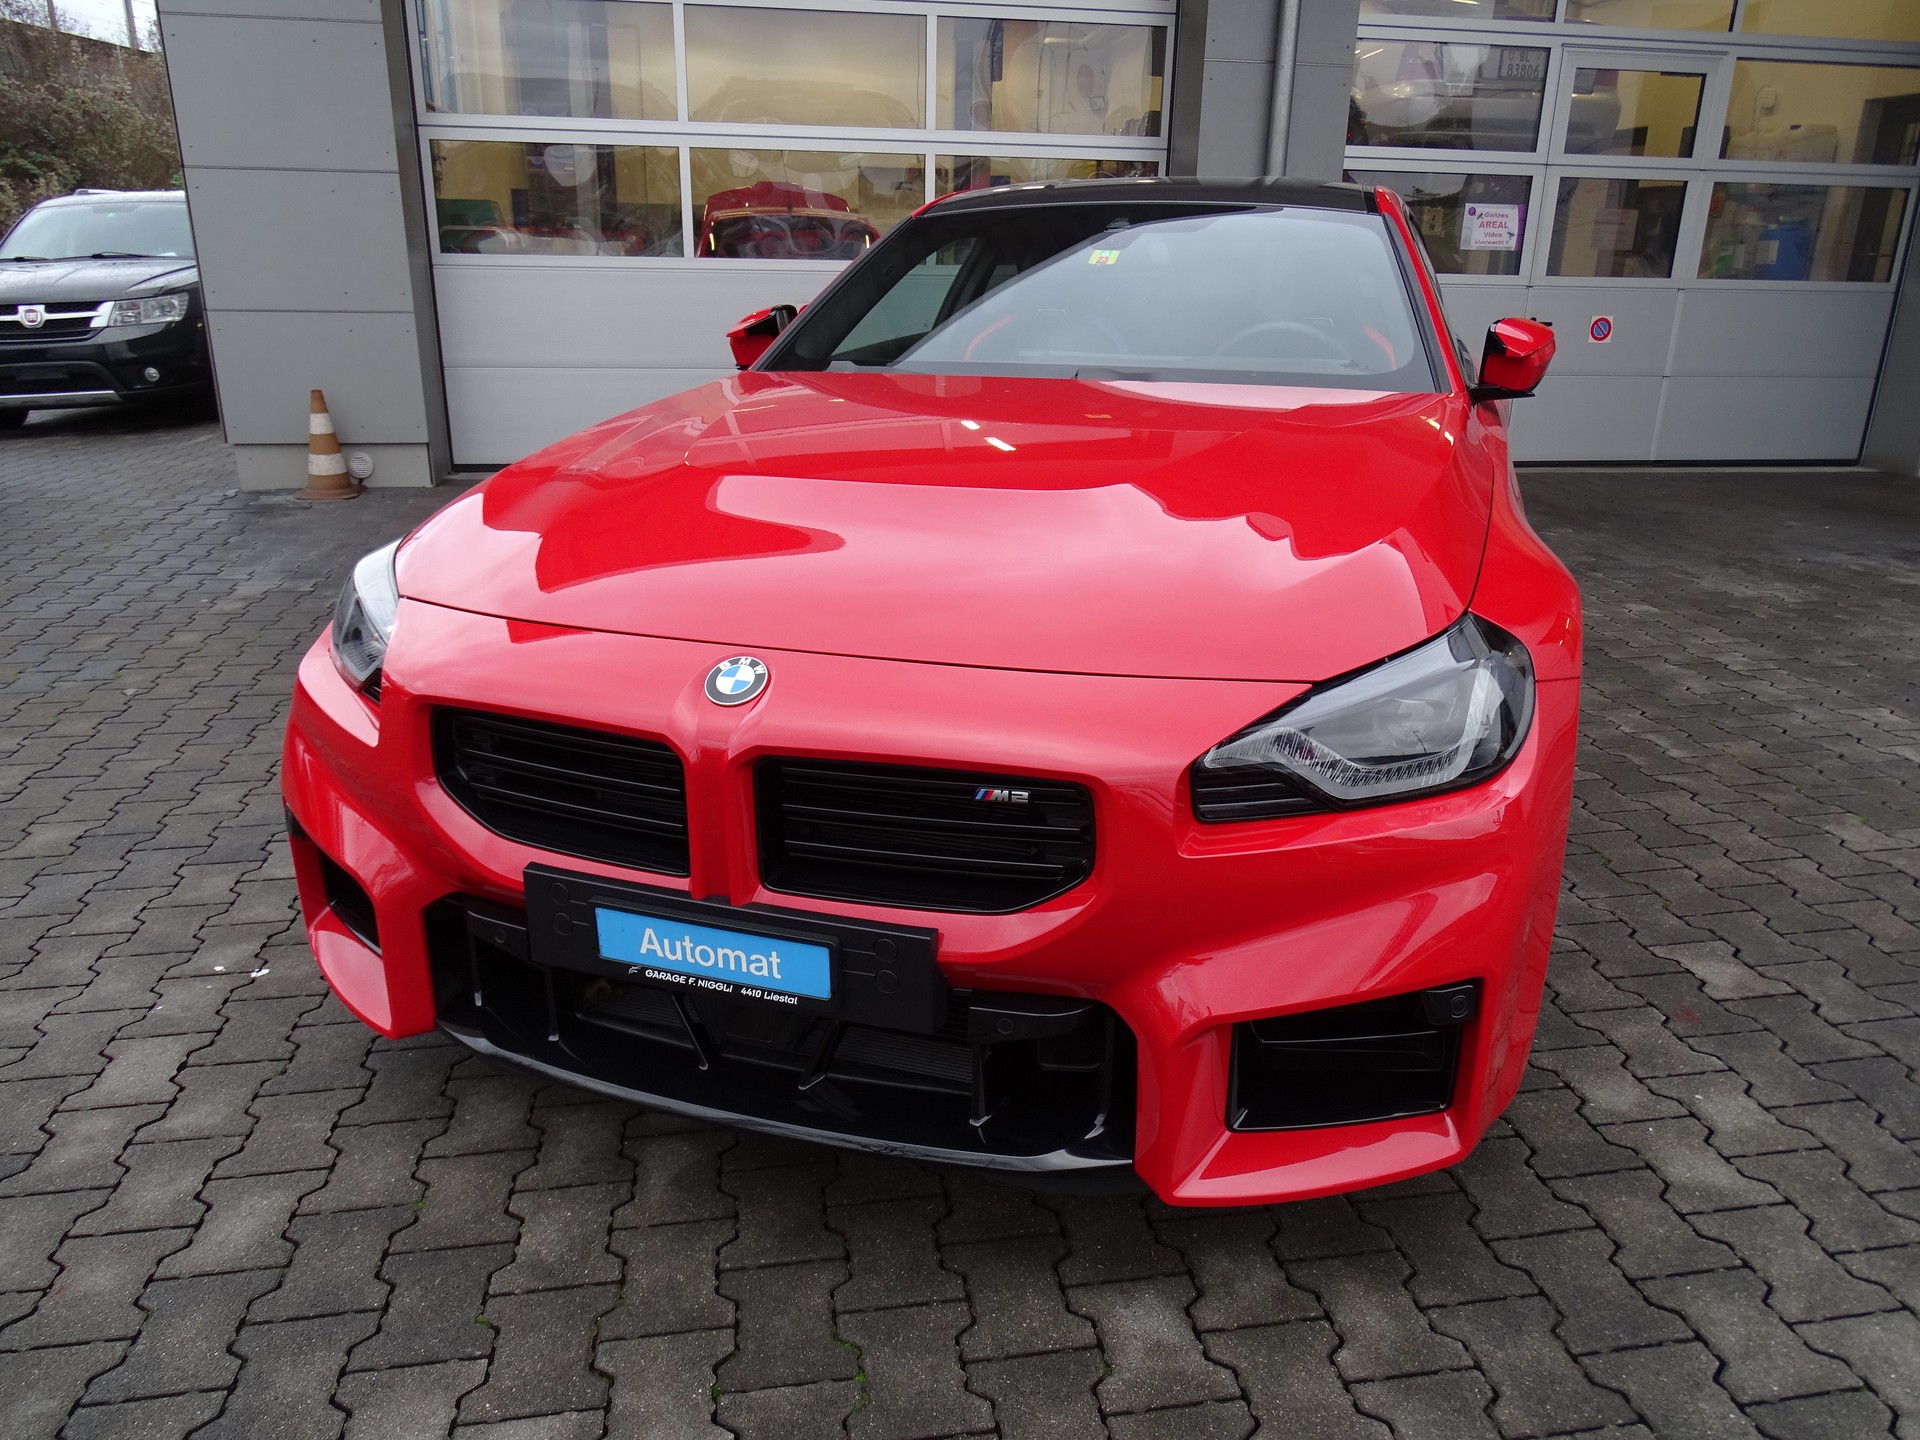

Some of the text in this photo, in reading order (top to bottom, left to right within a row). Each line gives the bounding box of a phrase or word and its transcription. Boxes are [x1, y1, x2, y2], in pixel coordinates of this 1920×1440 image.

[1506, 63, 1539, 78] 83806
[1478, 221, 1509, 229] AREAL
[719, 657, 765, 674] BMW
[639, 927, 782, 980] Automat
[645, 969, 798, 1005] GARAGE F. NIGGLI 4410 Liestal
